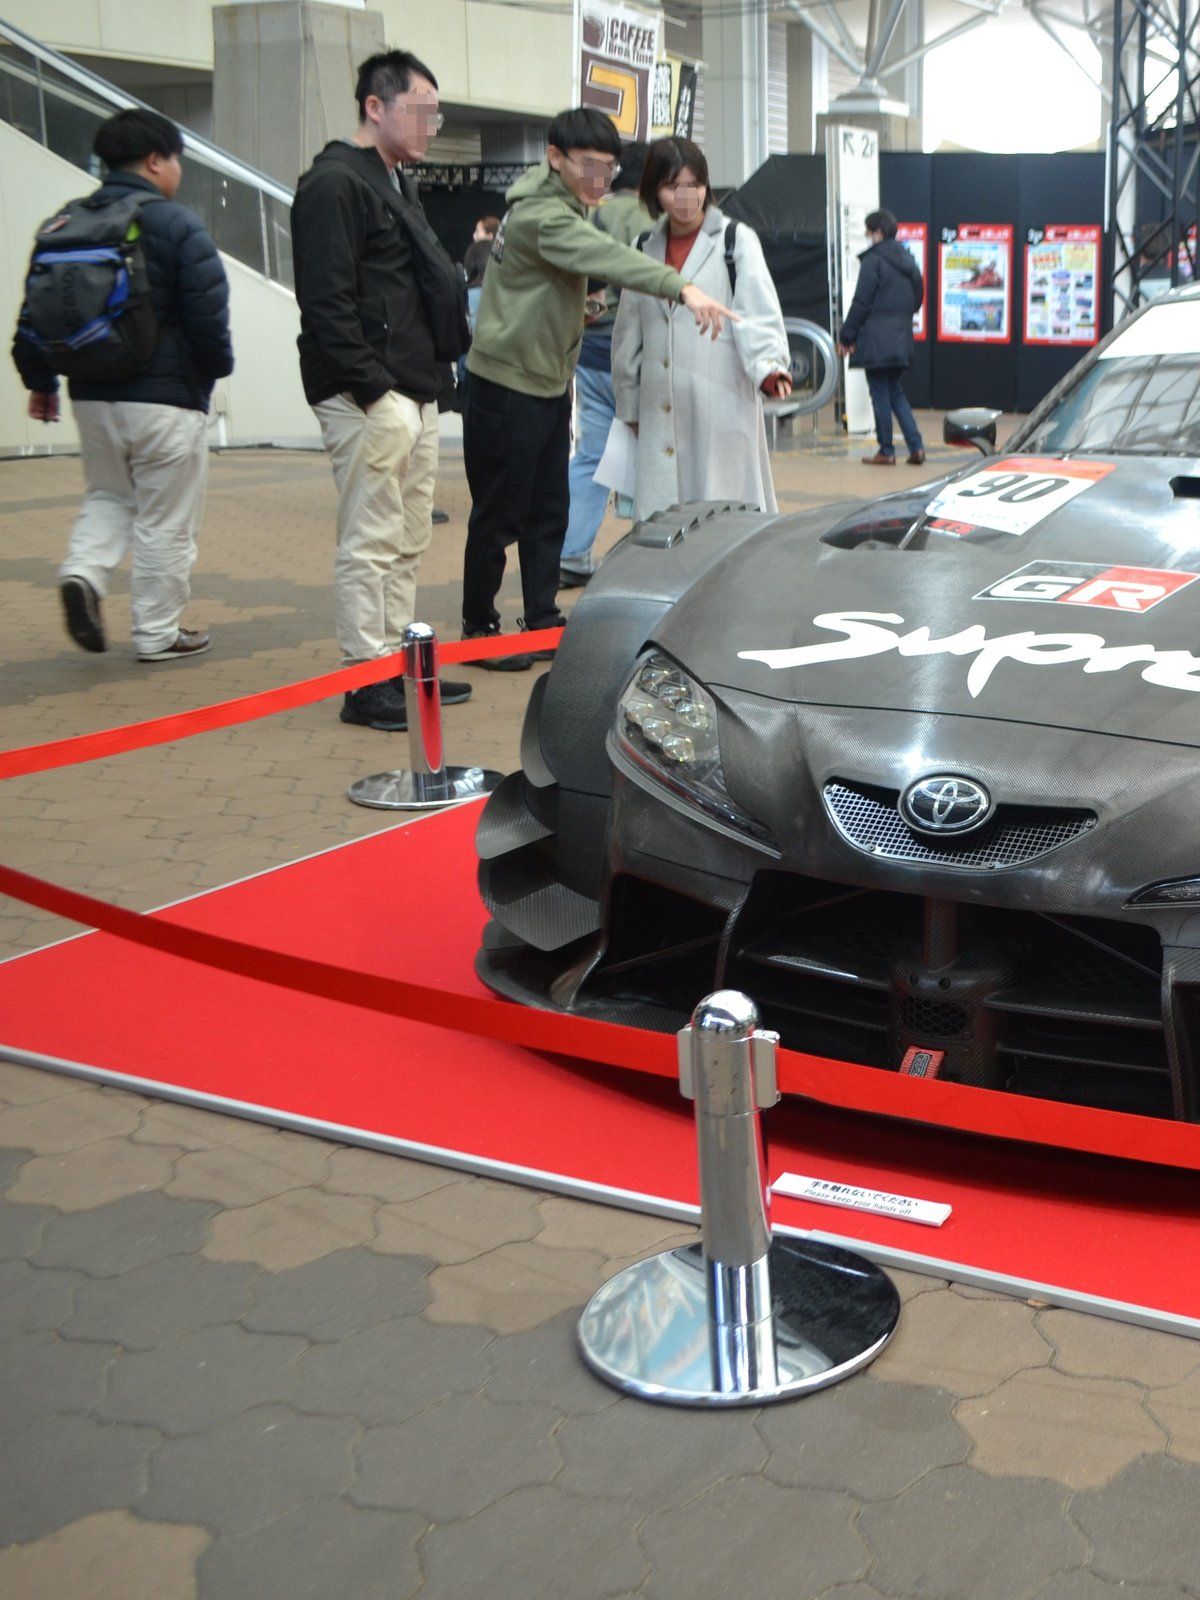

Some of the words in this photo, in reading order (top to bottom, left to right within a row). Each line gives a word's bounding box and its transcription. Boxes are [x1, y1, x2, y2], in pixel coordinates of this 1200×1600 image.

[610, 18, 656, 50] COFFEE
[861, 134, 876, 160] 2F
[957, 474, 1071, 503] 90
[989, 575, 1166, 610] GR
[804, 1189, 829, 1199] Please
[832, 1194, 852, 1204] keep
[854, 1200, 872, 1208] your
[874, 1202, 897, 1213] hands
[899, 1208, 912, 1216] off
[811, 1180, 919, 1207] 手を触れないでください
